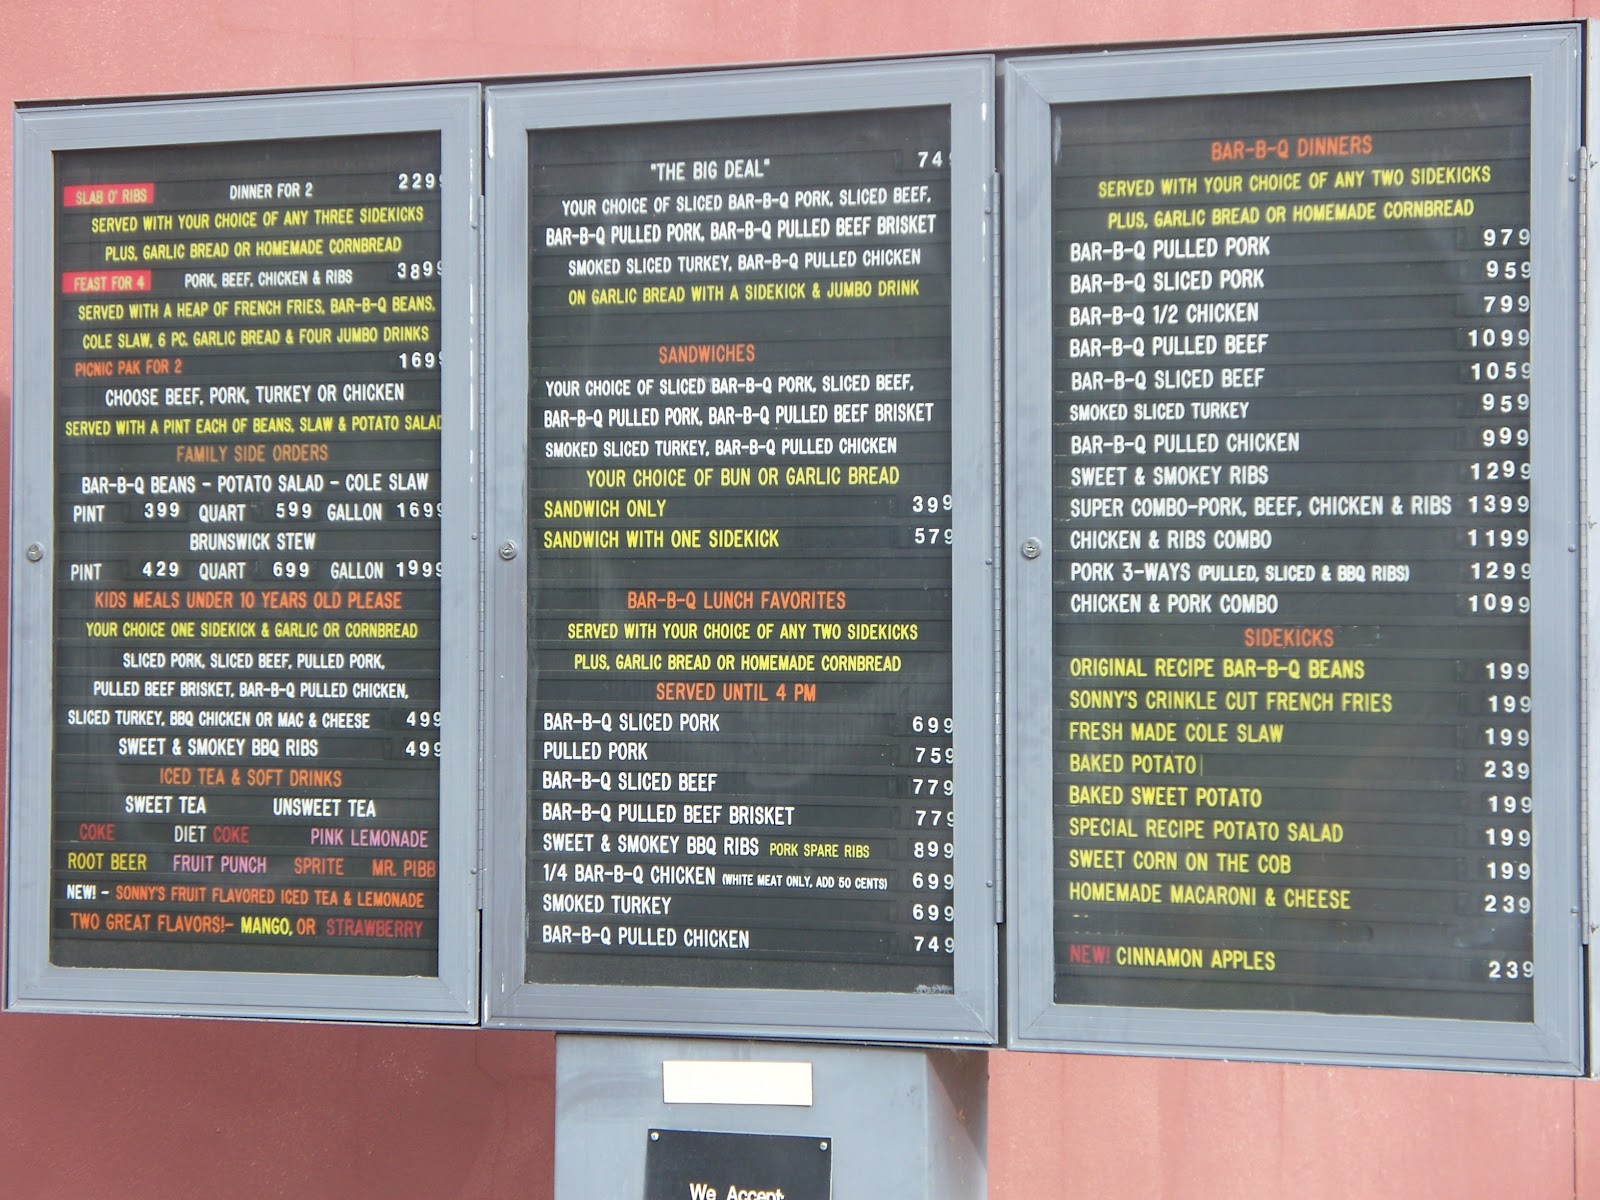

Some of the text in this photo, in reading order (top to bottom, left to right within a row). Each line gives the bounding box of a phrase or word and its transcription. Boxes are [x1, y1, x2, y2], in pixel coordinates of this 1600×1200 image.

[1211, 134, 1372, 161] BAR-B-Q DINNERS
[692, 160, 717, 180] BIG
[229, 183, 273, 200] DINNER
[276, 182, 300, 198] FOR
[304, 181, 313, 197] 2
[1098, 164, 1491, 198] SERVED WITH YOUR CHOICE OF ANY TWO SIDEKICKS
[76, 189, 104, 205] SLAB
[122, 187, 147, 204] RIBS
[91, 205, 424, 233] SERVED WITH YOUR CHOICE OF ANY THREE SIDEKICKS
[1070, 228, 1530, 262] BAR-B-Q PULLED PORK 979
[74, 274, 145, 292] FEAST FOR 4
[658, 343, 755, 364] SANDWICHES
[74, 360, 113, 377] PICNIC
[117, 360, 140, 375] PAK
[145, 358, 169, 374] FOR
[174, 358, 182, 374] 2
[176, 443, 328, 462] FAMILY SIDE ORDERS
[586, 465, 900, 488] YOUR CHOICE OF BUN OR GARLIC BREAD
[72, 504, 105, 523] PINT
[143, 501, 180, 518] 399
[198, 503, 246, 523] QUART
[275, 500, 312, 519] 599
[326, 502, 382, 522] GALLON
[544, 494, 952, 518] SANDWICH ONLY 399
[189, 532, 316, 551] BRUNSWICK STEW
[1070, 528, 1529, 550] CHICKEN & RIBS COMBO 1199
[1070, 561, 1410, 583] PORK 3-WAYS (PULLED, SLICED & BBQ RIBS)
[95, 590, 402, 609] KIDS MEALS UNDER 10 YEARS OLD PLEASE
[627, 590, 846, 610] BAR-B-Q LUNCH FAVORITES
[1244, 627, 1334, 647] SIDEKICKS
[1070, 657, 1529, 680] ORIGINAL RECIPE BAR-B-Q BEANS 199
[93, 680, 409, 699] PULLED BEEF BRISKET, BAR-B-Q PULLED CHICKEN,
[656, 682, 816, 702] SERVED UNTIL 4 PM
[543, 712, 953, 734] BAR-B-Q SLICED PORK 699
[1069, 753, 1530, 780] BAKED POTATO 239
[159, 767, 342, 787] ICED TEA & SOFT DRINKS
[124, 795, 206, 814] SWEET TEA
[272, 797, 376, 818] UNSWEET TEA
[79, 823, 114, 841] COKE
[310, 827, 428, 848] PINK LEMONADE
[1069, 816, 1343, 843] SPECIAL RECIPE POTATO SALAD
[769, 842, 870, 858] PORK SPARE RIBS
[67, 852, 147, 870] ROOT BEER
[173, 854, 267, 873] FRUIT PUNCH
[294, 856, 344, 875] SPRITE
[721, 873, 887, 890] (WHITE MEAT ONLY, ADD 50 CENTS)
[542, 893, 954, 922] SMOKED TURKEY 699
[70, 911, 100, 929] TWO
[105, 912, 151, 931] GREAT
[240, 916, 294, 936] MANGO,
[296, 917, 316, 936] OR
[326, 918, 424, 938] STRAWBERRY
[1116, 946, 1203, 968] CINNAMON
[1210, 949, 1275, 971] APPLES
[689, 1183, 717, 1200] We
